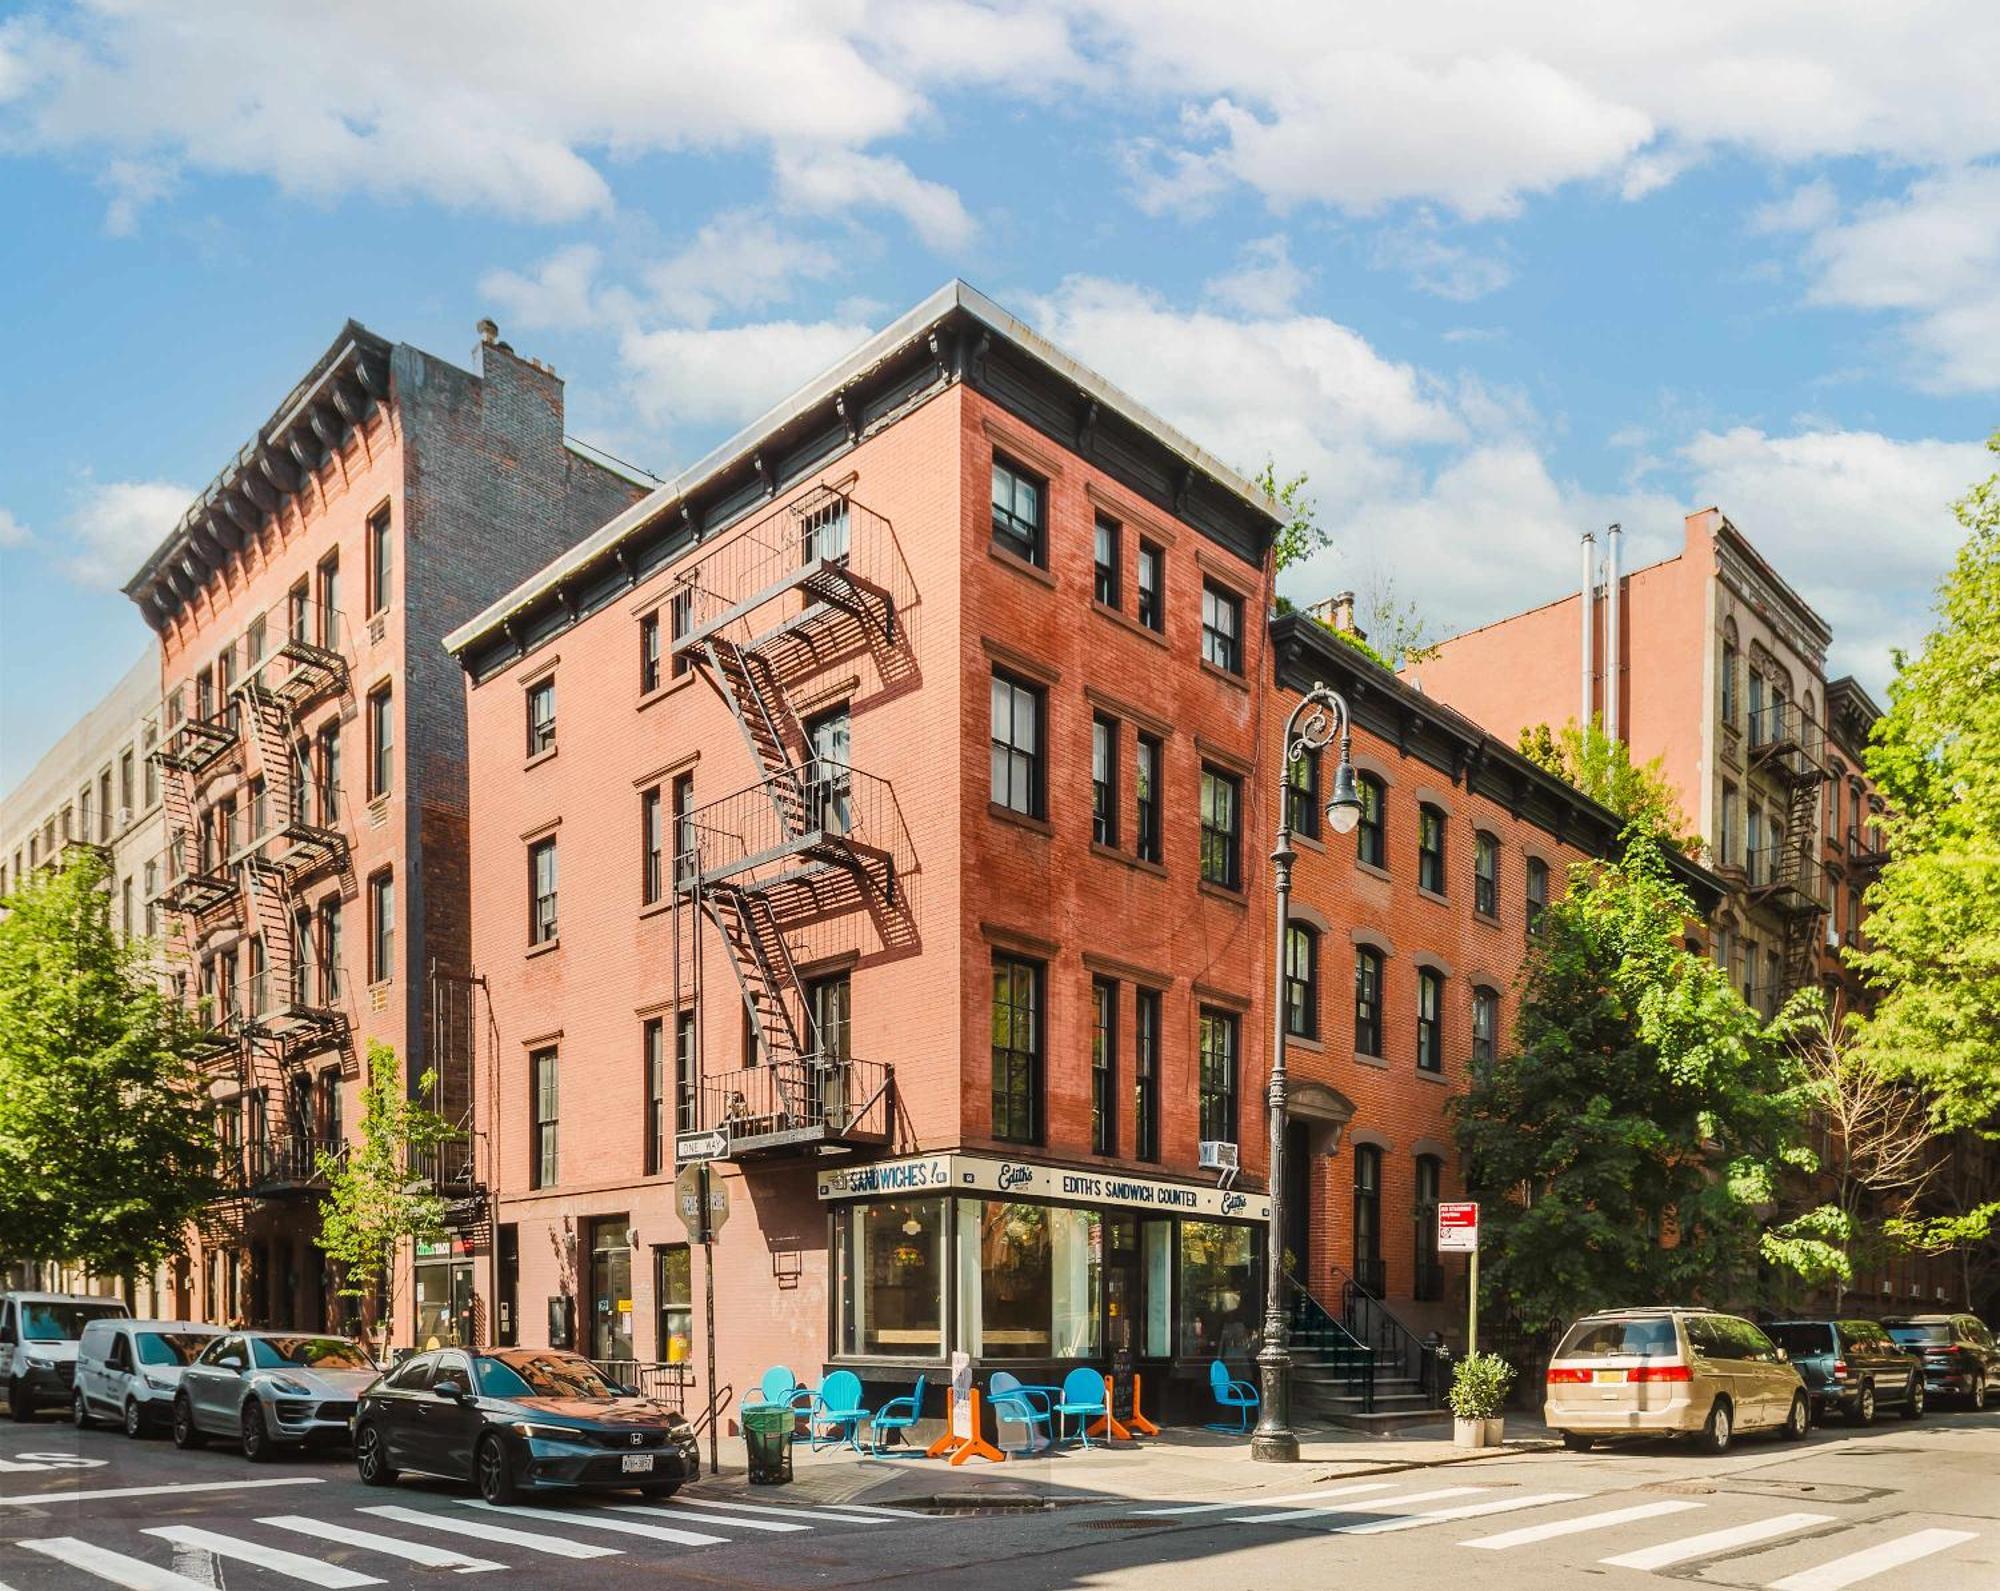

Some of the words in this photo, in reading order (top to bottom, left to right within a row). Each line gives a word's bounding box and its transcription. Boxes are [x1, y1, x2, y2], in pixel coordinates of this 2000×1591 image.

[683, 1142, 699, 1154] ONE
[706, 1139, 721, 1150] WAY
[998, 1164, 1033, 1190] Edith's
[1063, 1175, 1101, 1196] EDITH'S
[1105, 1181, 1154, 1203] SANDWICH
[1158, 1187, 1197, 1208] COUNTER
